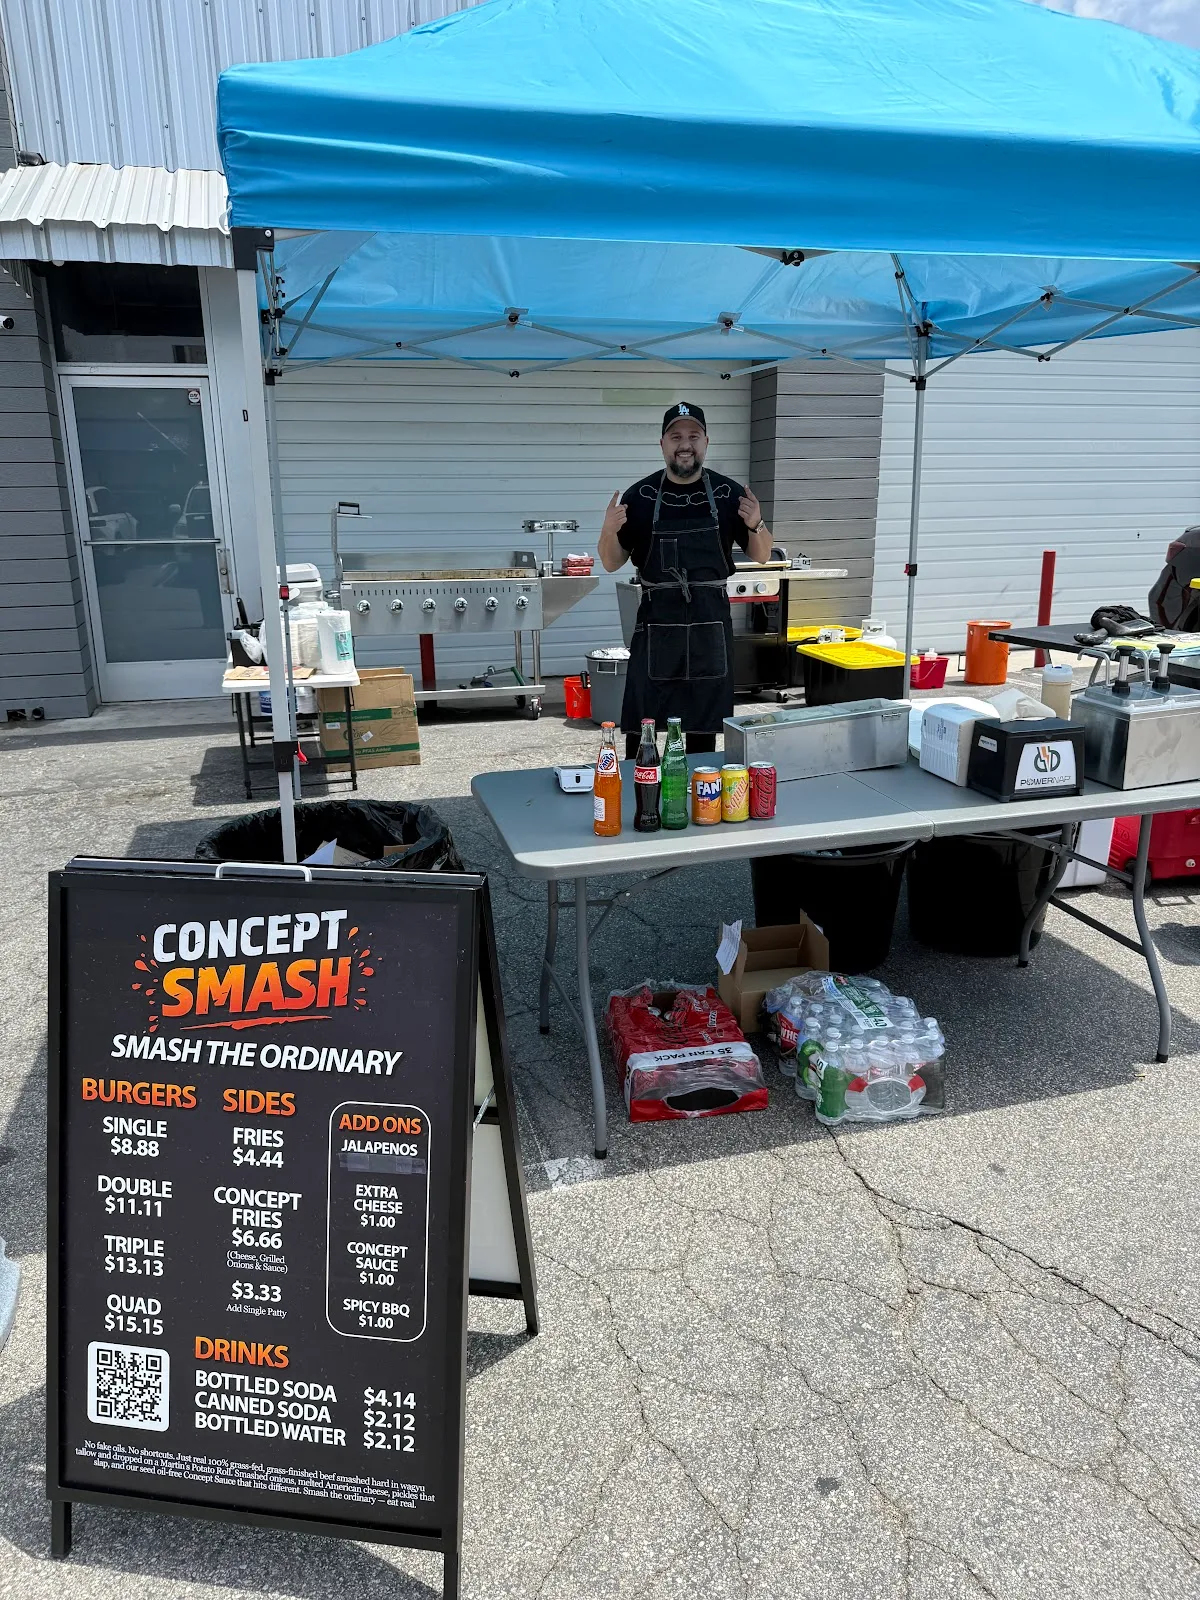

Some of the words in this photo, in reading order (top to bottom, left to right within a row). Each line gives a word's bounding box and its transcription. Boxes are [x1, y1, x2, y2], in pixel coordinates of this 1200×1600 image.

[678, 404, 690, 416] LA
[1020, 776, 1071, 786] POWERNAP
[153, 910, 348, 962] CONCEPT
[162, 956, 352, 1017] SMASH
[111, 1034, 201, 1064] SMASH
[206, 1040, 257, 1066] THE
[259, 1043, 402, 1076] ORDINARY
[655, 1053, 684, 1061] PACK
[82, 1077, 197, 1109] BURGERS
[223, 1089, 296, 1116] SIDES
[103, 1116, 167, 1138] SINGLE
[339, 1114, 380, 1131] ADD
[383, 1117, 421, 1134] ONS
[110, 1137, 159, 1158] $8.88
[233, 1127, 284, 1147] FRIES
[341, 1139, 417, 1156] JALAPENOS
[232, 1147, 284, 1169] $4.44
[98, 1175, 172, 1198] DOUBLE
[356, 1184, 398, 1199] EXTRA
[105, 1195, 162, 1217] $11.11
[214, 1186, 302, 1210] CONCEPT
[354, 1199, 403, 1214] CHEESE
[233, 1208, 282, 1229] FRIES
[360, 1214, 395, 1228] $1.00
[104, 1235, 164, 1257] TRIPLE
[232, 1227, 282, 1249] $6.66
[227, 1250, 258, 1262] (Cheese,
[260, 1254, 285, 1263] Grilled
[347, 1242, 408, 1258] CONCEPT
[105, 1254, 164, 1276] $13.13
[227, 1260, 254, 1269] Onions
[255, 1261, 261, 1270] &
[263, 1263, 288, 1274] Sauce)
[356, 1257, 398, 1272] SAUCE
[360, 1271, 394, 1286] $1.00
[232, 1280, 281, 1302] $3.33
[107, 1294, 161, 1315] QUAD
[226, 1304, 242, 1312] Add
[243, 1305, 266, 1316] Single
[268, 1308, 287, 1319] Patty
[343, 1299, 380, 1313] SPICY
[382, 1302, 410, 1318] BBQ
[105, 1313, 164, 1335] $15.15
[359, 1314, 393, 1329] $1.00
[195, 1336, 289, 1368] DRINKS
[195, 1370, 279, 1396] BOTTLED
[283, 1380, 337, 1403] SODA
[364, 1387, 416, 1409] $4.14
[195, 1391, 274, 1416] CANNED
[278, 1401, 332, 1423] SODA
[363, 1408, 416, 1431] $2.12
[195, 1411, 279, 1437] BOTTLED
[282, 1422, 346, 1446] WATER
[363, 1429, 415, 1452] $2.12
[76, 1448, 97, 1458] tallow
[98, 1451, 111, 1460] and
[112, 1453, 142, 1466] dropped
[160, 1459, 190, 1470] Martin's
[192, 1464, 215, 1474] Potato
[217, 1467, 233, 1476] Roll.
[235, 1470, 268, 1481] Smashed
[270, 1475, 295, 1485] onions,
[298, 1478, 323, 1488] melted
[325, 1482, 361, 1493] American
[363, 1487, 390, 1497] cheese,
[392, 1489, 418, 1500] pickles
[420, 1493, 435, 1502] that
[84, 1440, 95, 1449] No
[97, 1442, 111, 1451] fake
[113, 1444, 127, 1453] oils.
[128, 1446, 139, 1455] No
[140, 1448, 175, 1459] shortcuts.
[176, 1453, 192, 1462] Just
[193, 1454, 206, 1464] real
[208, 1458, 228, 1467] 100%
[230, 1462, 265, 1474] grass-fed,
[266, 1466, 318, 1479] grass-finished
[320, 1471, 336, 1481] beef
[337, 1474, 370, 1485] smashed
[372, 1478, 389, 1488] hard
[391, 1480, 399, 1489] in
[400, 1484, 425, 1493] wagyu
[94, 1458, 110, 1469] slap,
[111, 1461, 125, 1469] and
[127, 1464, 138, 1472] our
[140, 1465, 155, 1474] seed
[157, 1468, 182, 1478] oil-free
[183, 1472, 213, 1483] Concept
[215, 1476, 236, 1485] Sauce
[237, 1479, 252, 1487] that
[253, 1481, 267, 1490] hits
[268, 1483, 301, 1494] different.
[303, 1487, 329, 1497] Smash
[330, 1491, 342, 1499] the
[344, 1493, 376, 1505] ordinary
[400, 1500, 416, 1509] real.
